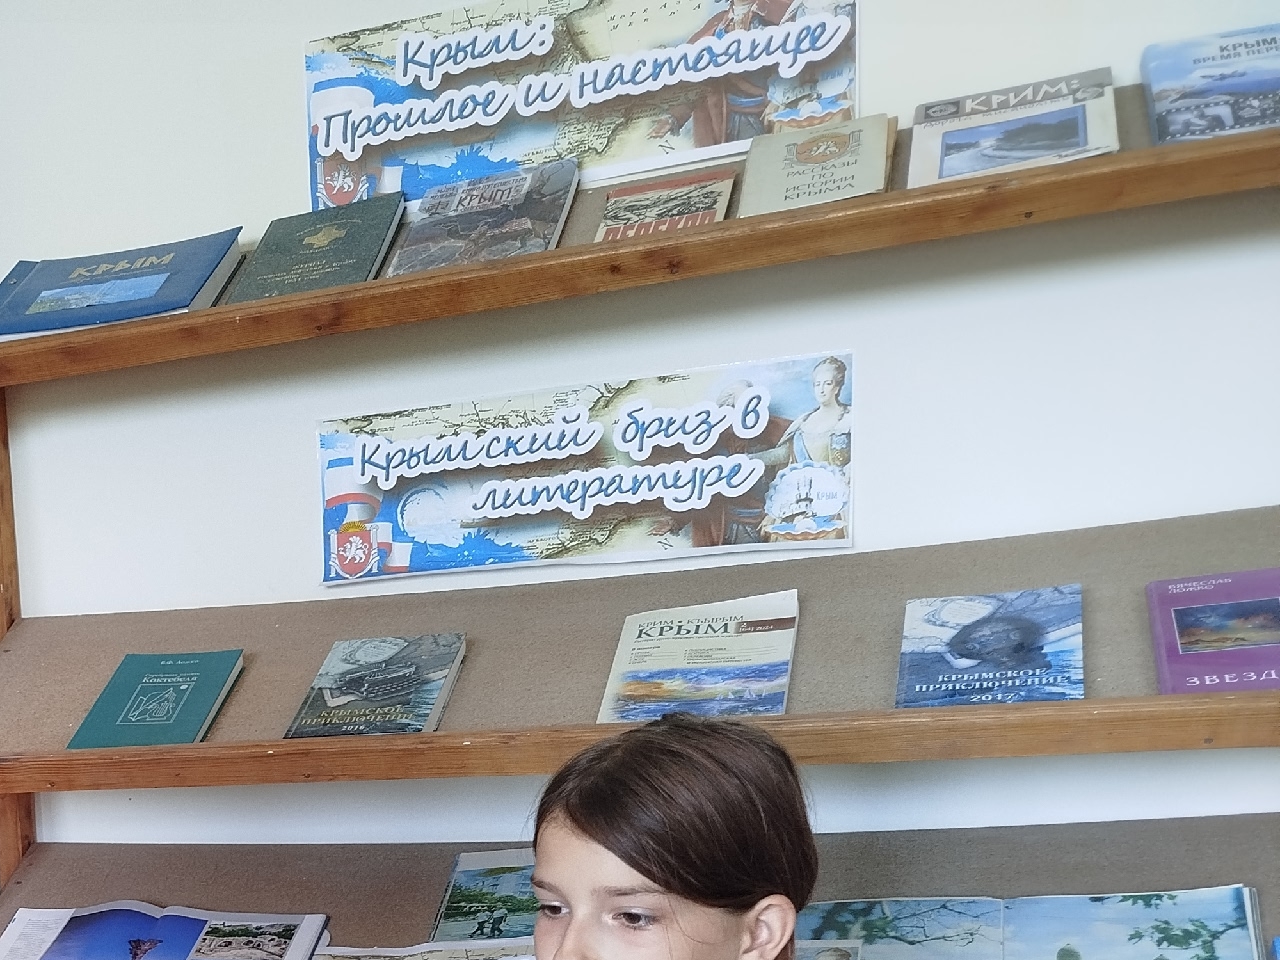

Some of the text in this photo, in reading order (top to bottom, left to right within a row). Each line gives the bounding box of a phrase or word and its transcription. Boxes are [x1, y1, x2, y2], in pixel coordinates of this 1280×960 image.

[401, 22, 549, 81] Крым:
[322, 21, 841, 151] Прошлое и настоящее
[786, 159, 858, 178] РАССКАЗЫ
[811, 171, 834, 180] ПО
[783, 184, 855, 201] КРЫМА
[785, 174, 855, 193] ИСТОРИИ
[68, 252, 175, 279] КРЫМ
[359, 416, 596, 480] Крымский
[620, 406, 722, 453] бриз
[472, 459, 756, 511] литературе
[635, 622, 731, 640] КРЫМ
[915, 675, 1070, 692] ПРИКЛЮЧЕНИЕ
[938, 668, 1048, 682] КРЫМСКОЕ
[1186, 669, 1280, 686] ЗВЕЗД
[970, 692, 1018, 702] 2017
[320, 705, 405, 717] КРЫМСКОЕ
